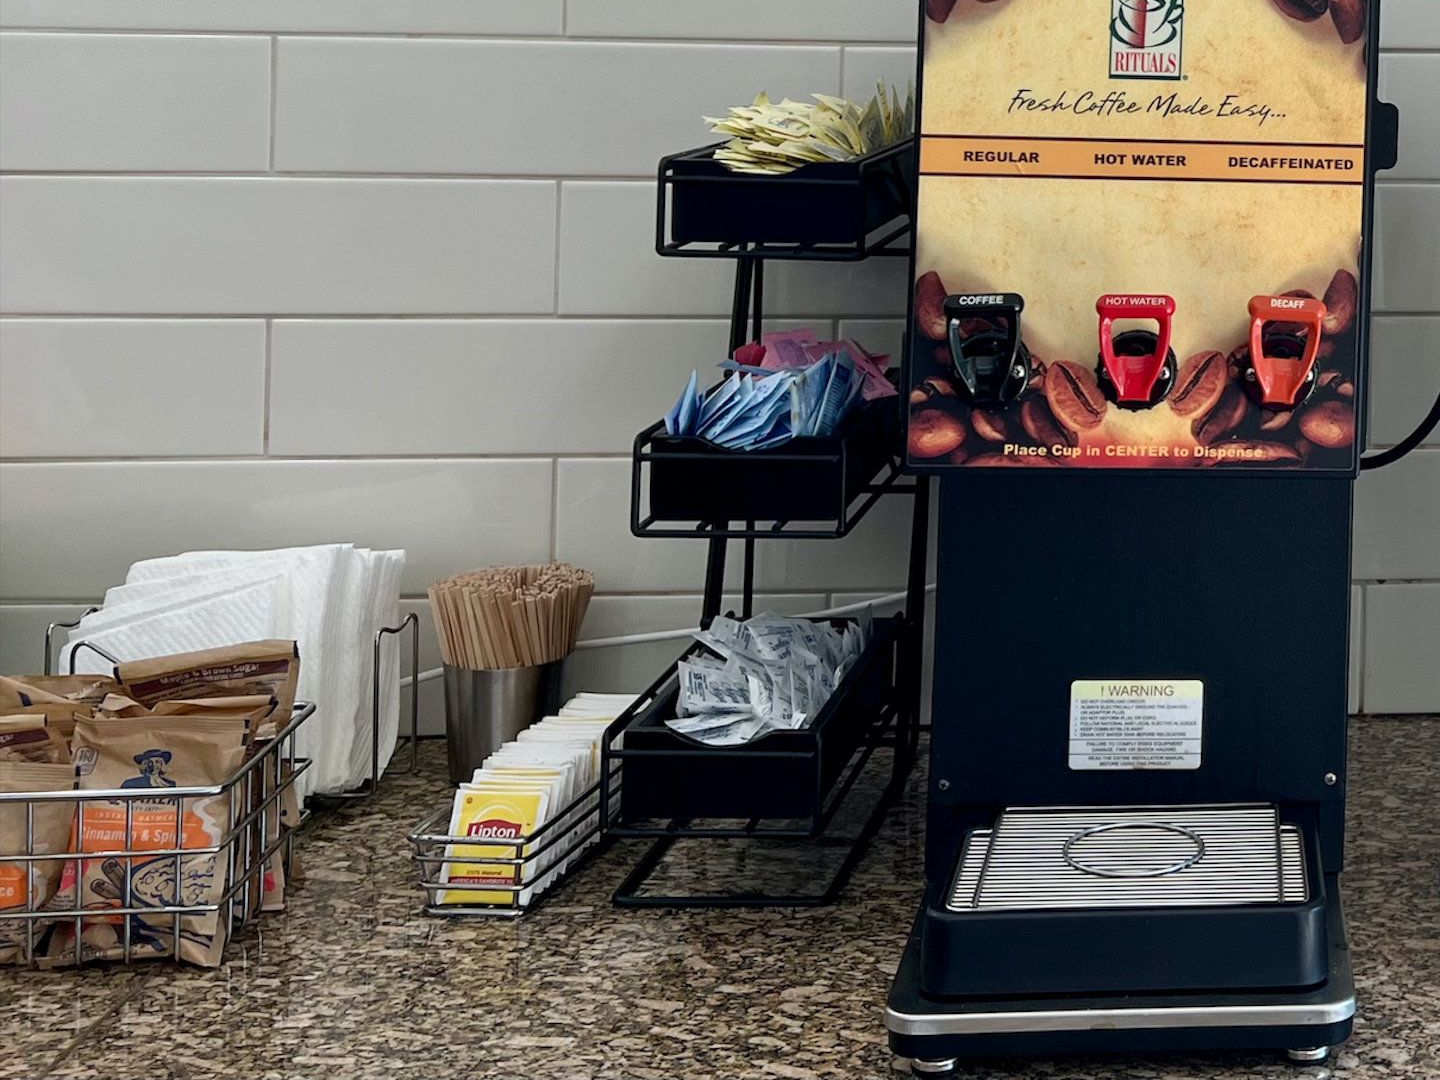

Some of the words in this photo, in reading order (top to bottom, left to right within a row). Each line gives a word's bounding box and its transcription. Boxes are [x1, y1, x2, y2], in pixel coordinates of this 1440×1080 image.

[1115, 52, 1177, 73] RITUALS
[1008, 89, 1072, 113] Fresh
[1073, 91, 1143, 116] Coffee
[1146, 93, 1214, 118] Made
[963, 151, 1040, 164] REGULAR
[1094, 154, 1128, 166] HOT
[1131, 154, 1187, 167] WATER
[1228, 156, 1354, 171] DECAFFEINATED
[959, 295, 1004, 305] COFFEE
[1105, 297, 1128, 306] HOT
[1130, 297, 1166, 306] WATER
[1270, 298, 1305, 309] DECAFF
[1003, 444, 1047, 457] Place
[1051, 444, 1081, 459] Cup
[1086, 444, 1100, 457] in
[1105, 445, 1169, 457] CENTER
[1173, 446, 1189, 457] to
[1194, 445, 1263, 459] Dispense
[1109, 686, 1174, 696] WARNING
[140, 828, 150, 841] &
[470, 824, 517, 838] Lipton
